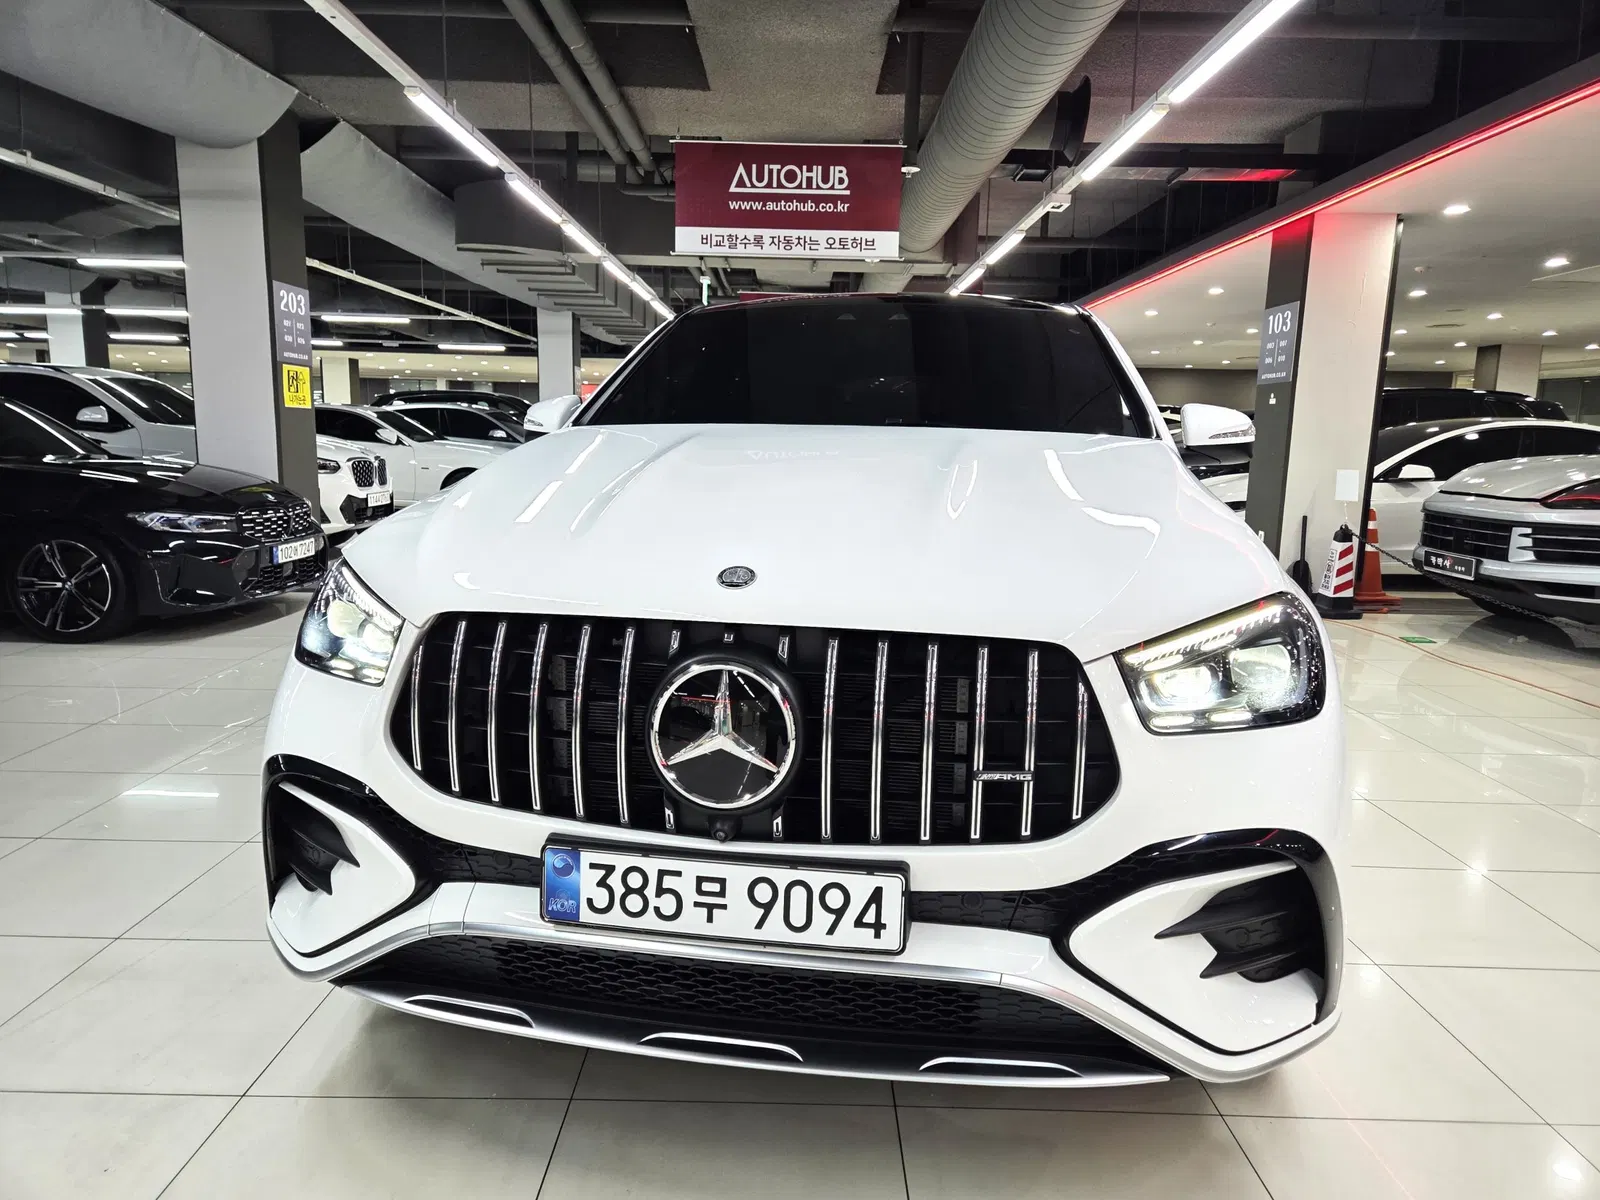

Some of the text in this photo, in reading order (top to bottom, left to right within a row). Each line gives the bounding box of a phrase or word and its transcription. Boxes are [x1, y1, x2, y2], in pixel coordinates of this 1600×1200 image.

[729, 162, 850, 195] AUTOHUB
[728, 199, 850, 213] www.autohub.co.kr
[700, 233, 876, 252] 비교할수록 자동차는 오토허브
[279, 289, 306, 316] 203
[1268, 310, 1291, 334] 103
[299, 540, 314, 557] 7247
[990, 773, 1032, 781] AMG
[547, 897, 577, 914] KOR
[586, 862, 887, 940] 385무 9094
